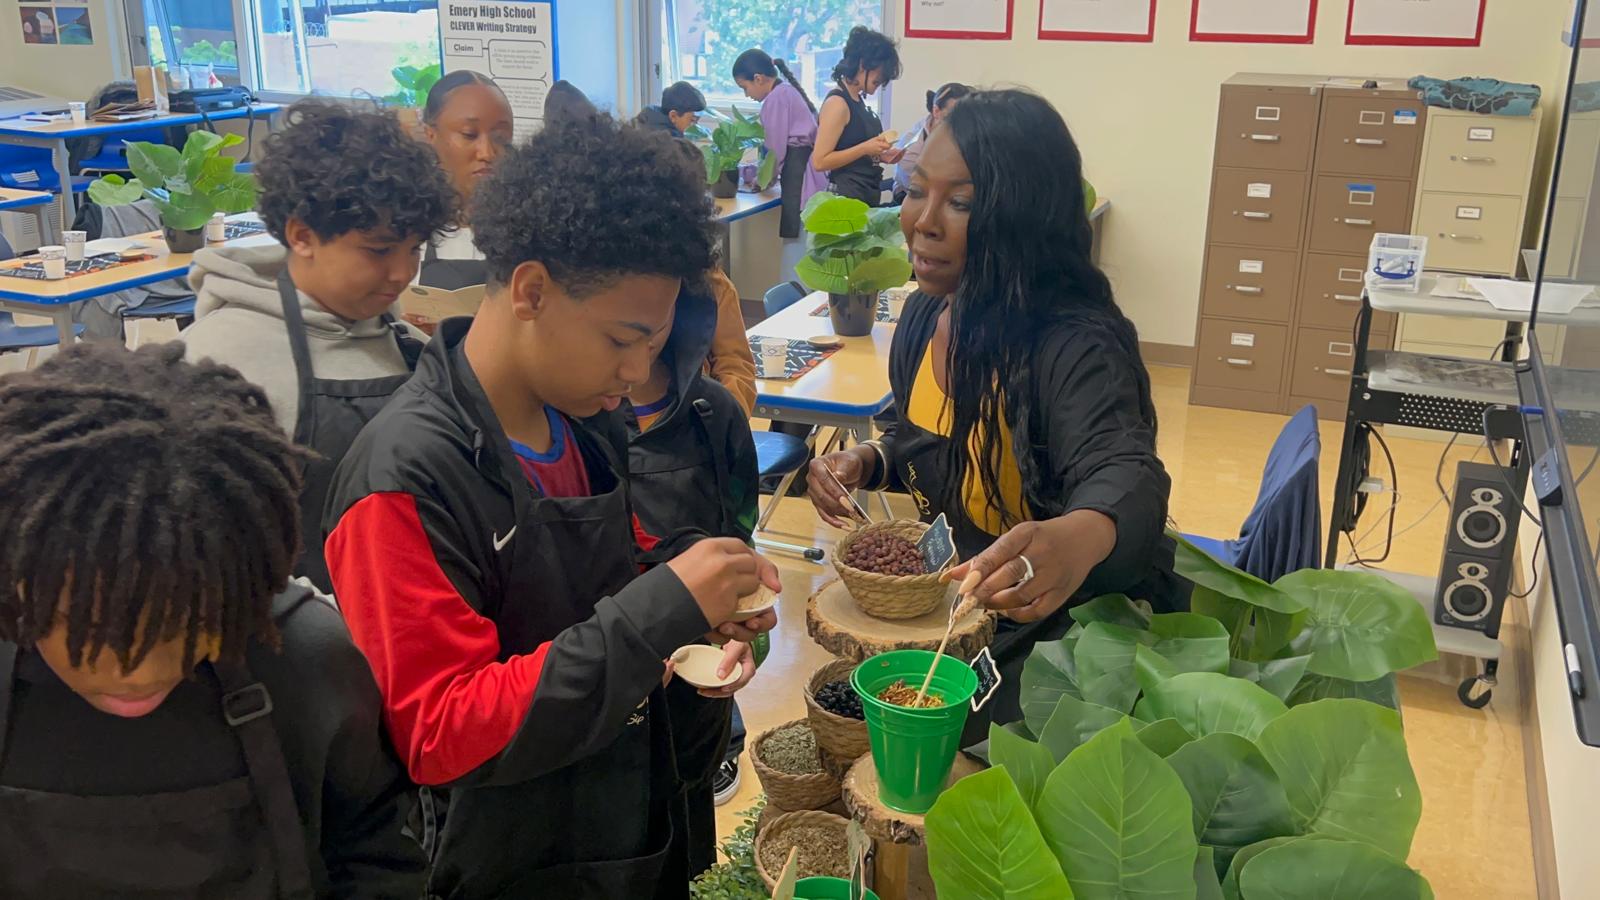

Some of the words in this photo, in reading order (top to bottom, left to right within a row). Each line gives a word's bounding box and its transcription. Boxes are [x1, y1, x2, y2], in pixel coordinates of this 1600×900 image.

[449, 5, 477, 18] Emery
[480, 5, 501, 18] High
[503, 6, 536, 19] School
[450, 21, 475, 31] CLEVER
[476, 22, 504, 33] Writing
[505, 23, 537, 34] Strategy
[453, 44, 474, 52] Claim
